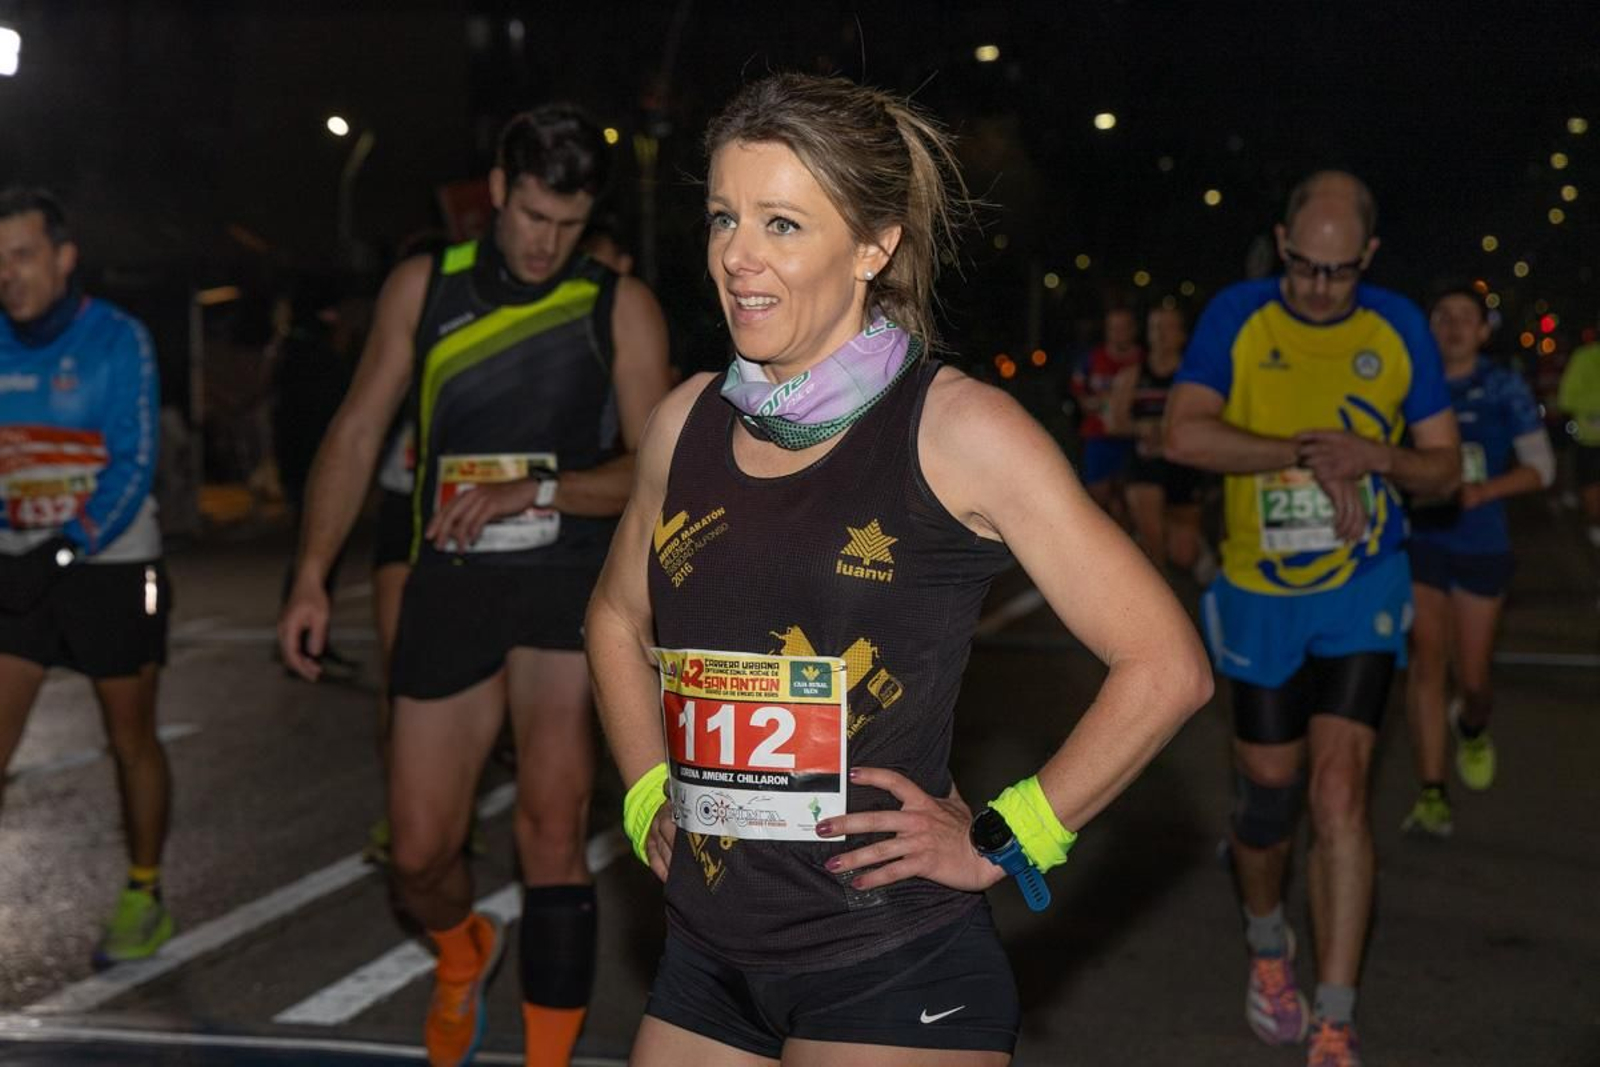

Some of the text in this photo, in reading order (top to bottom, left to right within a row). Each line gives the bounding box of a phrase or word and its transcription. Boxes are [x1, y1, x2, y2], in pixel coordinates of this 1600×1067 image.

[835, 560, 894, 583] luanvi
[704, 658, 779, 670] CARRERA URBANA
[704, 676, 728, 690] SAN
[678, 700, 796, 769] 112
[702, 770, 734, 782] JIMENEZ
[737, 774, 789, 786] CHILLARON
